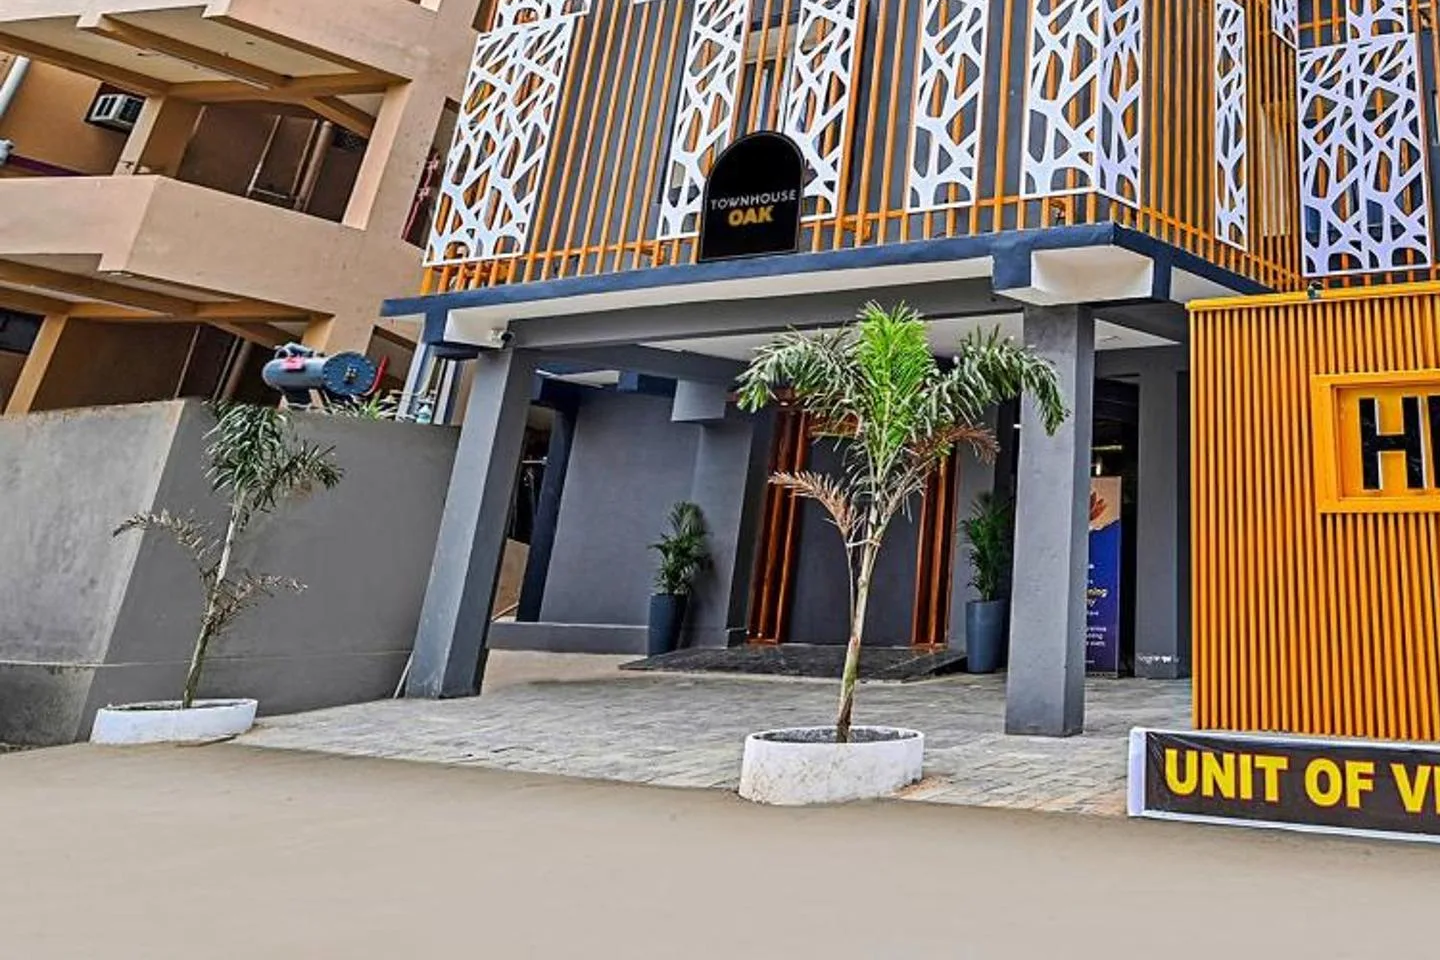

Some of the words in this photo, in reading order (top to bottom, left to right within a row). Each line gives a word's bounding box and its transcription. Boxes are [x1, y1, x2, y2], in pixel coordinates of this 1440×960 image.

[710, 189, 797, 211] TOWNHOUSE
[728, 205, 775, 227] OAK
[1163, 746, 1290, 804] UNIT
[1303, 756, 1376, 810] OF
